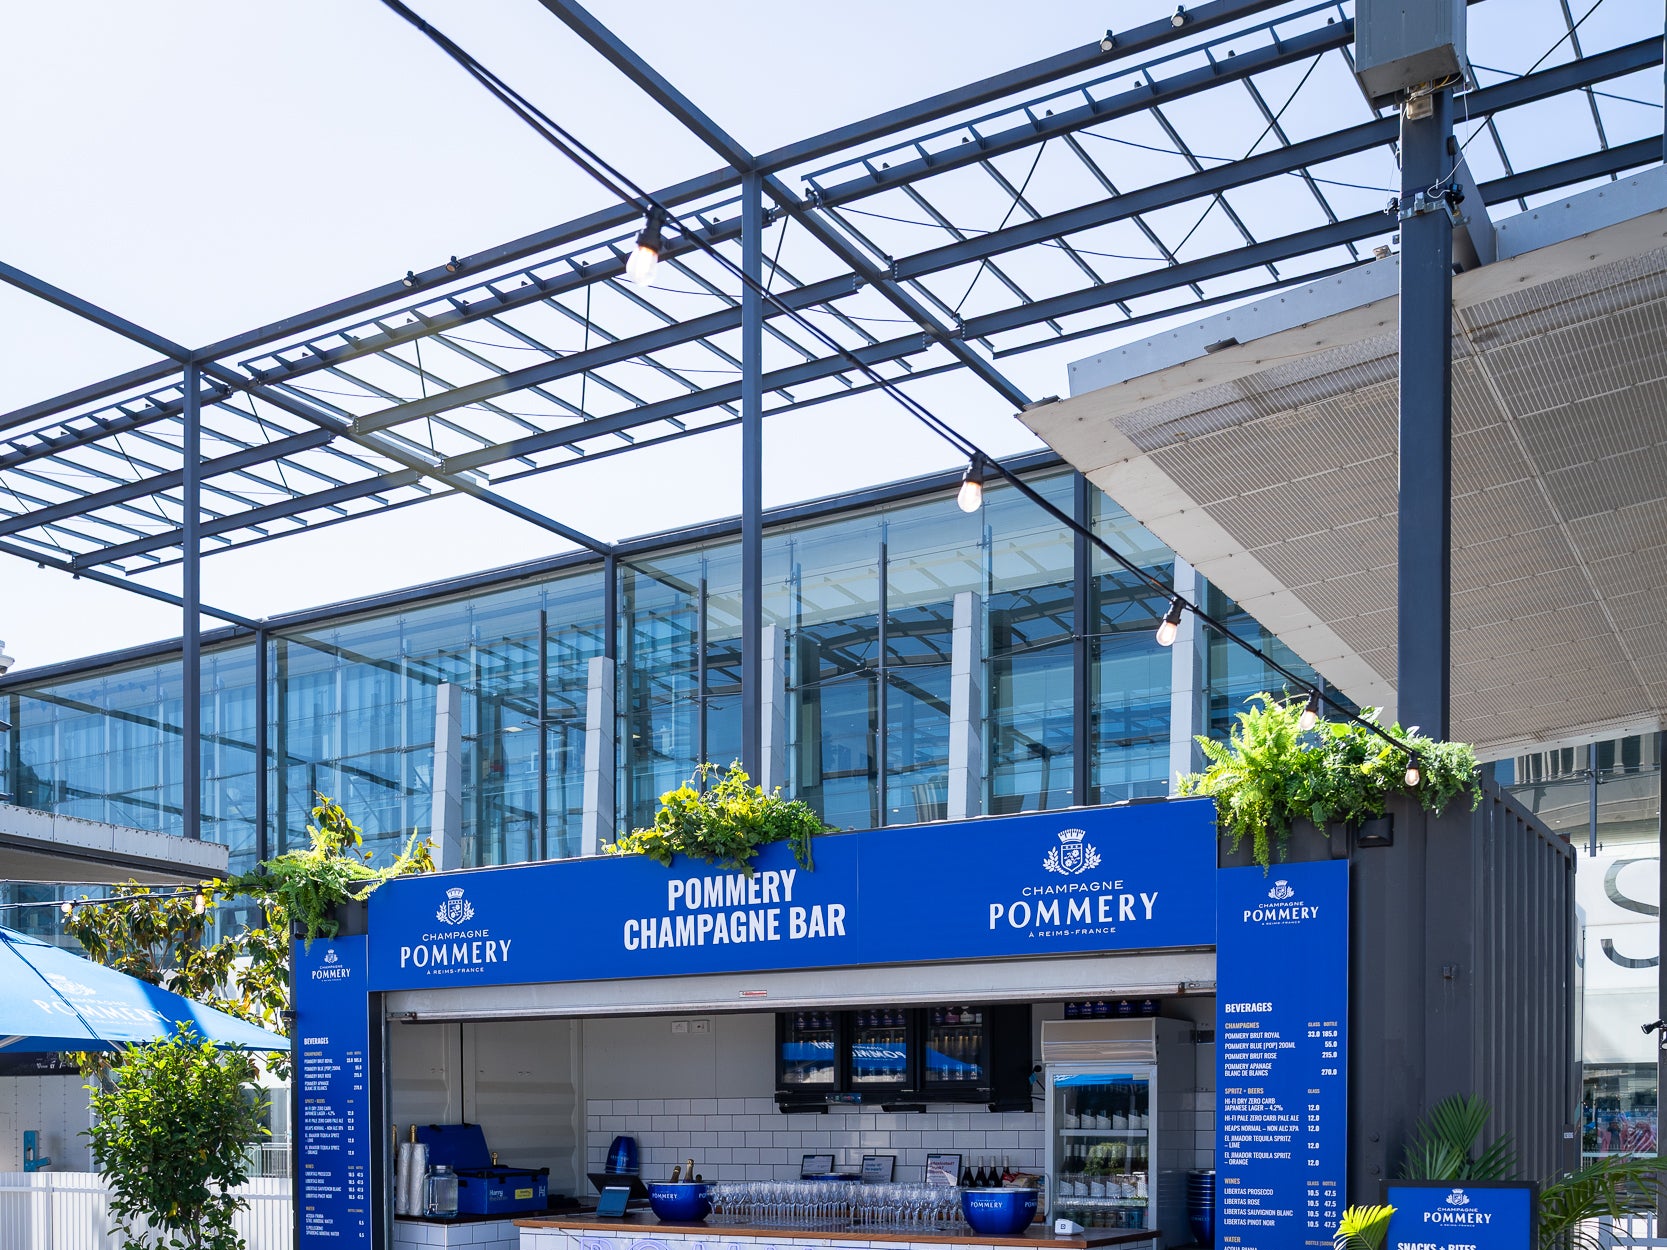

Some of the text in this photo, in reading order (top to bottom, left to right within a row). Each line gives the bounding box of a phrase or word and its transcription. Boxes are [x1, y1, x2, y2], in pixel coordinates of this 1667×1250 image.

[668, 869, 796, 911] POMMERY
[1022, 880, 1123, 896] CHAMPAGNE
[989, 892, 1158, 930] POMMERY
[1258, 901, 1304, 909] CHAMPAGNE
[1243, 906, 1319, 923] POMMERY
[624, 903, 846, 951] CHAMPAGNE BAR
[1039, 927, 1116, 937] REIMS-FRANCE
[422, 929, 489, 941] CHAMPAGNE
[400, 939, 511, 968] POMMERY
[312, 968, 351, 980] POMMERY
[1225, 1002, 1272, 1013] BEVERAGES
[304, 1037, 328, 1045] BEVERAGES
[1424, 1212, 1492, 1224] POMMERY
